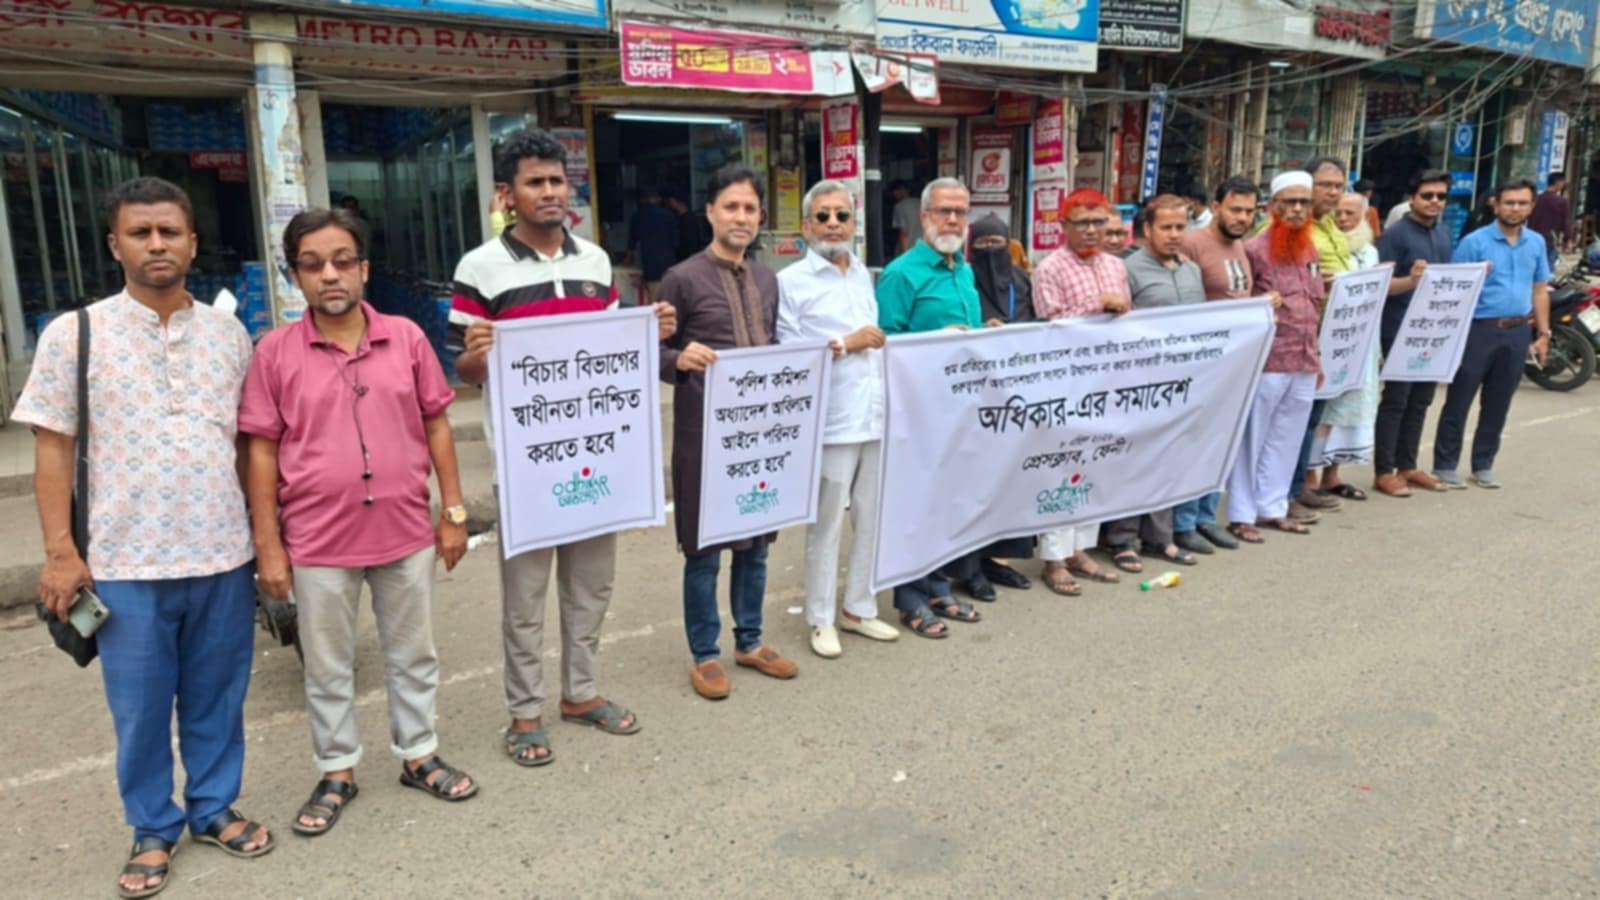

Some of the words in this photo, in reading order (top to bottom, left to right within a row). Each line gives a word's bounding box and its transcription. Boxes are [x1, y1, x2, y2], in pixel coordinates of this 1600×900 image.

[303, 19, 423, 53] METRO
[433, 28, 549, 62] BAZAR
[511, 355, 569, 386] “বিচার
[575, 350, 640, 379] বিভাগের
[728, 370, 768, 397] “পুলিশ
[771, 366, 810, 388] কমিশন
[511, 395, 583, 428] স্বাধীনতা
[587, 385, 642, 417] নিশ্চিত
[714, 402, 769, 424] অধ্যাদেশ
[772, 395, 813, 416] অবিলম্বে
[978, 390, 1110, 434] অধিকার-এর
[1115, 377, 1193, 414] সমাবেশ
[526, 437, 579, 465] করতে
[721, 430, 759, 450] আইনে
[726, 461, 761, 480] করতে
[1021, 449, 1087, 471] প্রেসক্লাব,
